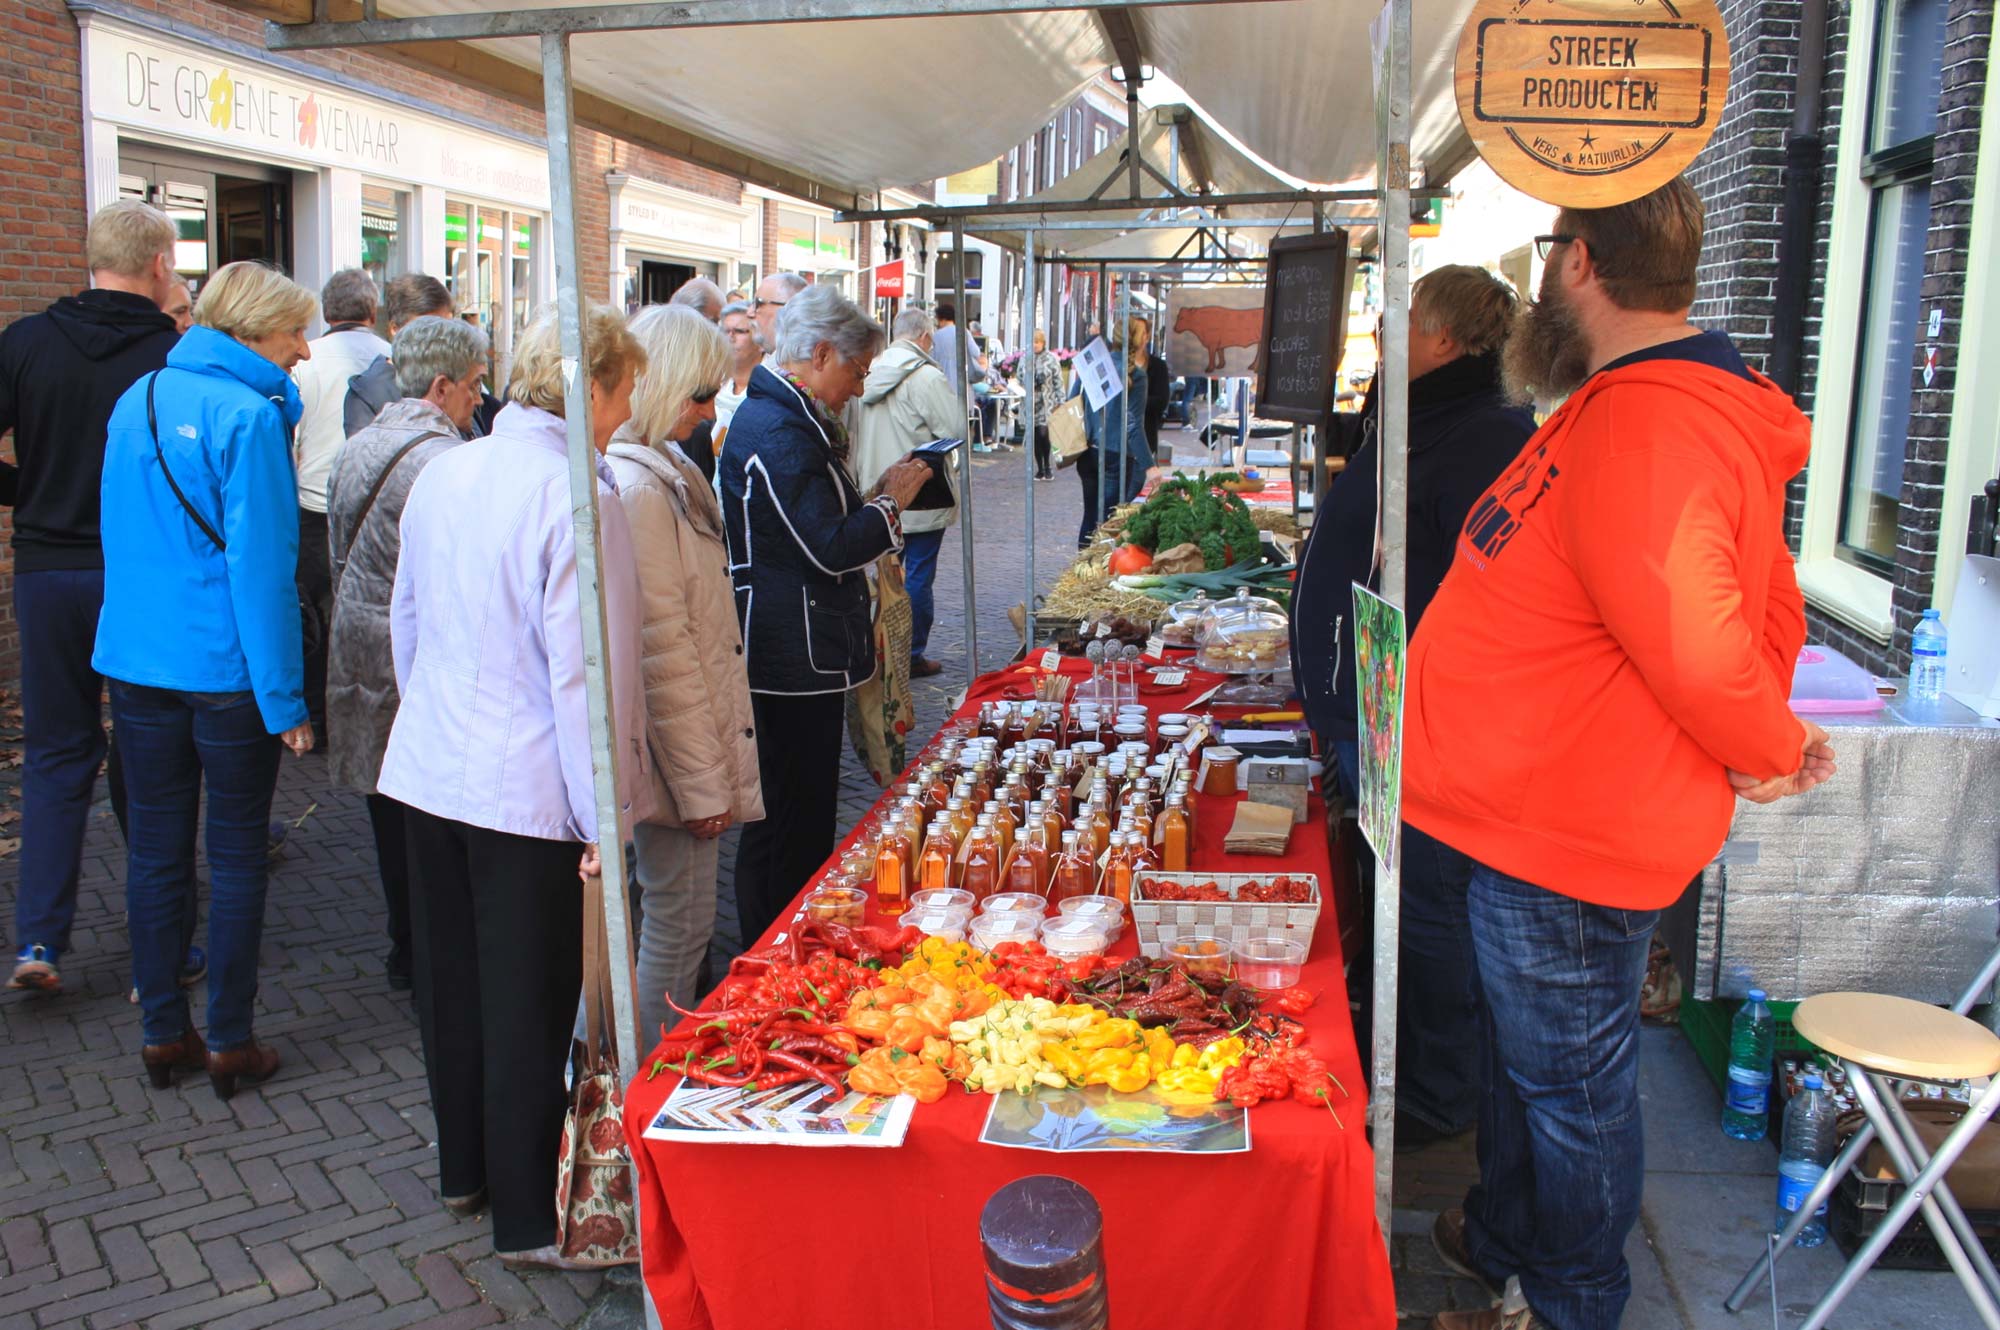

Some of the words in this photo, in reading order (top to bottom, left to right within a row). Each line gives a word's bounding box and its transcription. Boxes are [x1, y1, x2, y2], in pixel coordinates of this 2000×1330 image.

[1548, 35, 1639, 67] STREEK
[126, 51, 161, 112] DE
[1522, 77, 1659, 111] PRODUCTEN
[1532, 136, 1559, 158] VERS
[1562, 152, 1573, 164] &
[1578, 139, 1645, 166] NATUURLIJK
